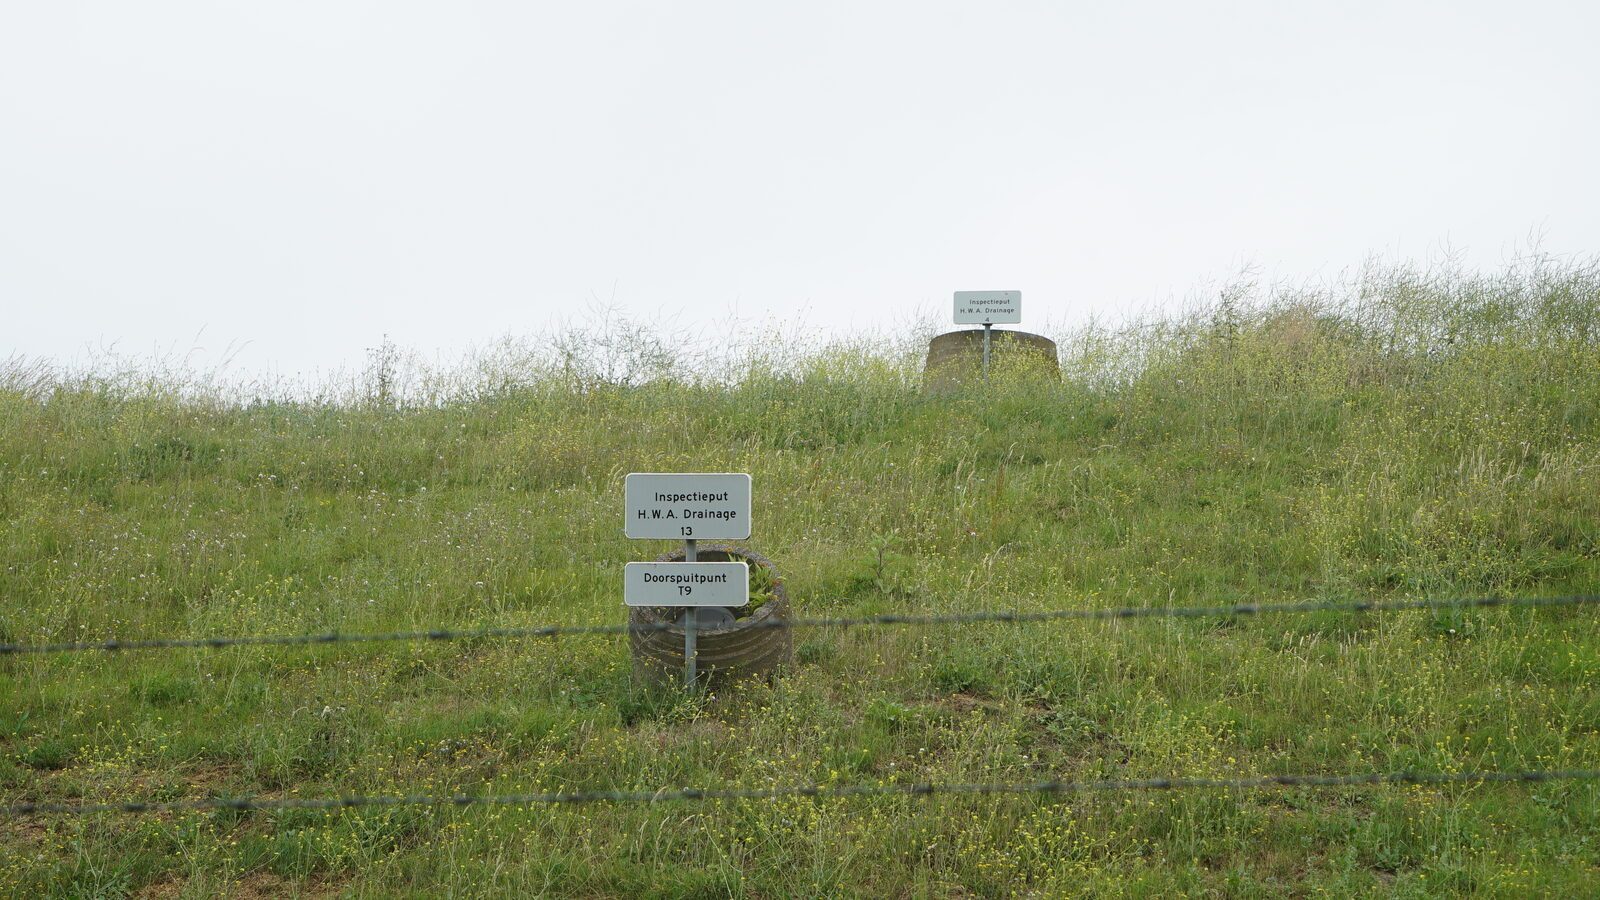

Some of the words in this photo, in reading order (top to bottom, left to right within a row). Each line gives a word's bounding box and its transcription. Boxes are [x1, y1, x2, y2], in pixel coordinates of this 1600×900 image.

[655, 491, 728, 503] Inspectieput
[638, 509, 678, 519] H.W.A.
[683, 509, 736, 521] Drainage
[680, 526, 693, 536] 13
[644, 572, 727, 584] Doorspuitpunt
[678, 586, 692, 596] T9
